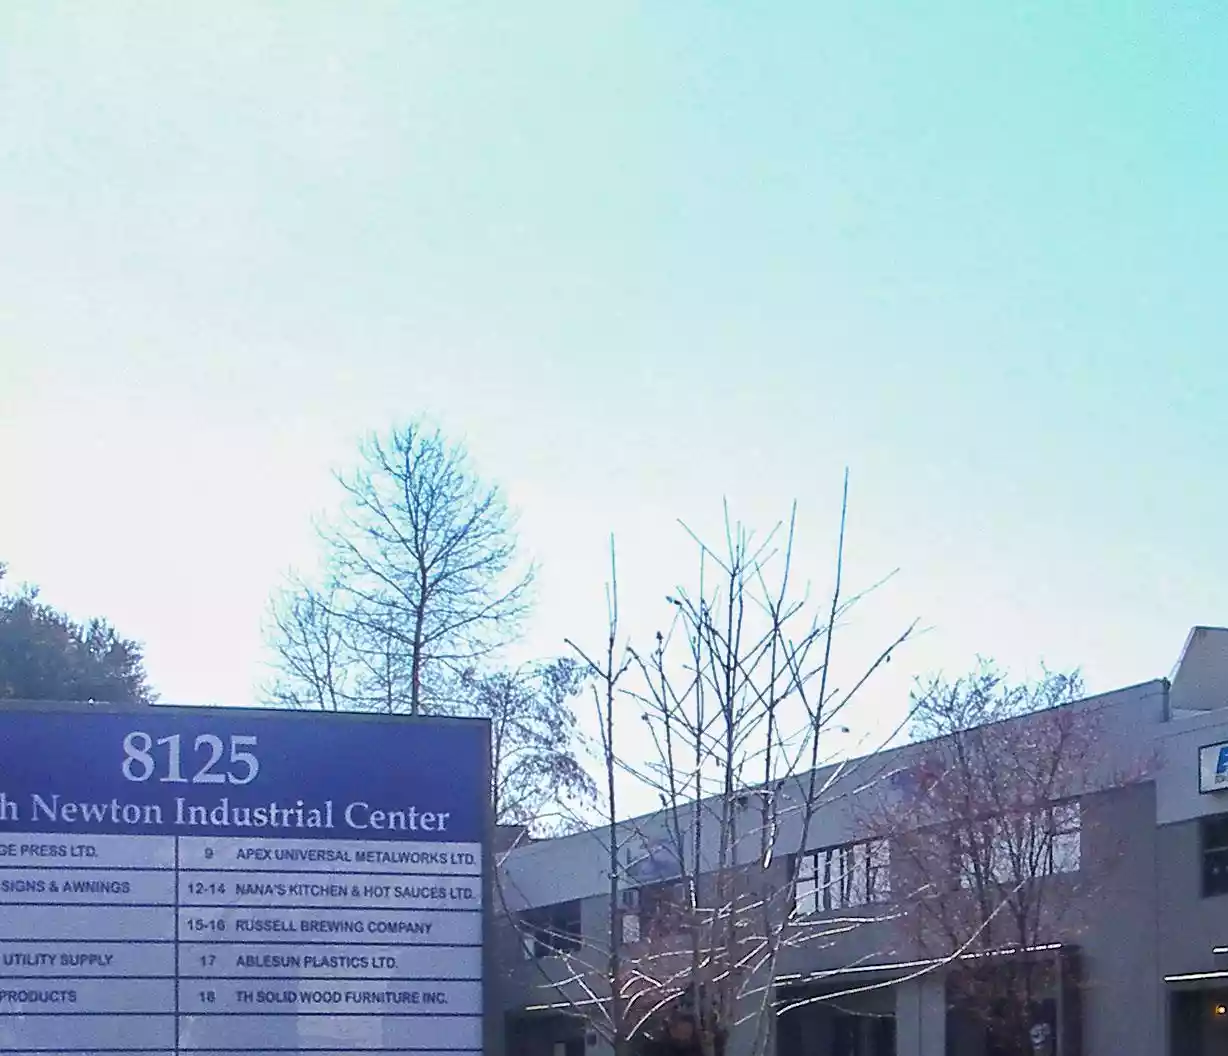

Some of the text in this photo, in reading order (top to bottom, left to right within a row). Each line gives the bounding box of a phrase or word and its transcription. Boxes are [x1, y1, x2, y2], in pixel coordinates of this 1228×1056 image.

[121, 731, 260, 785] 8125
[31, 794, 164, 824] Newton
[174, 798, 334, 831] Industrial
[344, 802, 450, 832] Center
[20, 844, 67, 857] PRESS
[70, 845, 99, 857] LTD.
[204, 847, 476, 865] 9 APEX UNIVERSAL METALWORKS LTD.
[1, 880, 130, 893] SIGNS & AWNINGS
[188, 882, 226, 894] 12-14
[235, 883, 287, 896] NANA'S
[289, 884, 348, 897] KITCHEN
[351, 886, 361, 898] &
[363, 886, 391, 898] HOT
[394, 887, 447, 899] SAUCES
[235, 919, 297, 932] RUSSELL
[301, 920, 364, 933] BREWING
[367, 921, 432, 934] COMPANY
[3, 953, 113, 966] UTILITY SUPPLY
[200, 955, 399, 969] 17 ABLESUN PLASTICS LTD.
[0, 990, 77, 1003] PRODUCTS
[236, 990, 253, 1003] TH
[256, 991, 296, 1004] SOLID
[299, 991, 342, 1004] WOOD
[345, 991, 420, 1004] FURNITURE
[422, 992, 448, 1005] INC.
